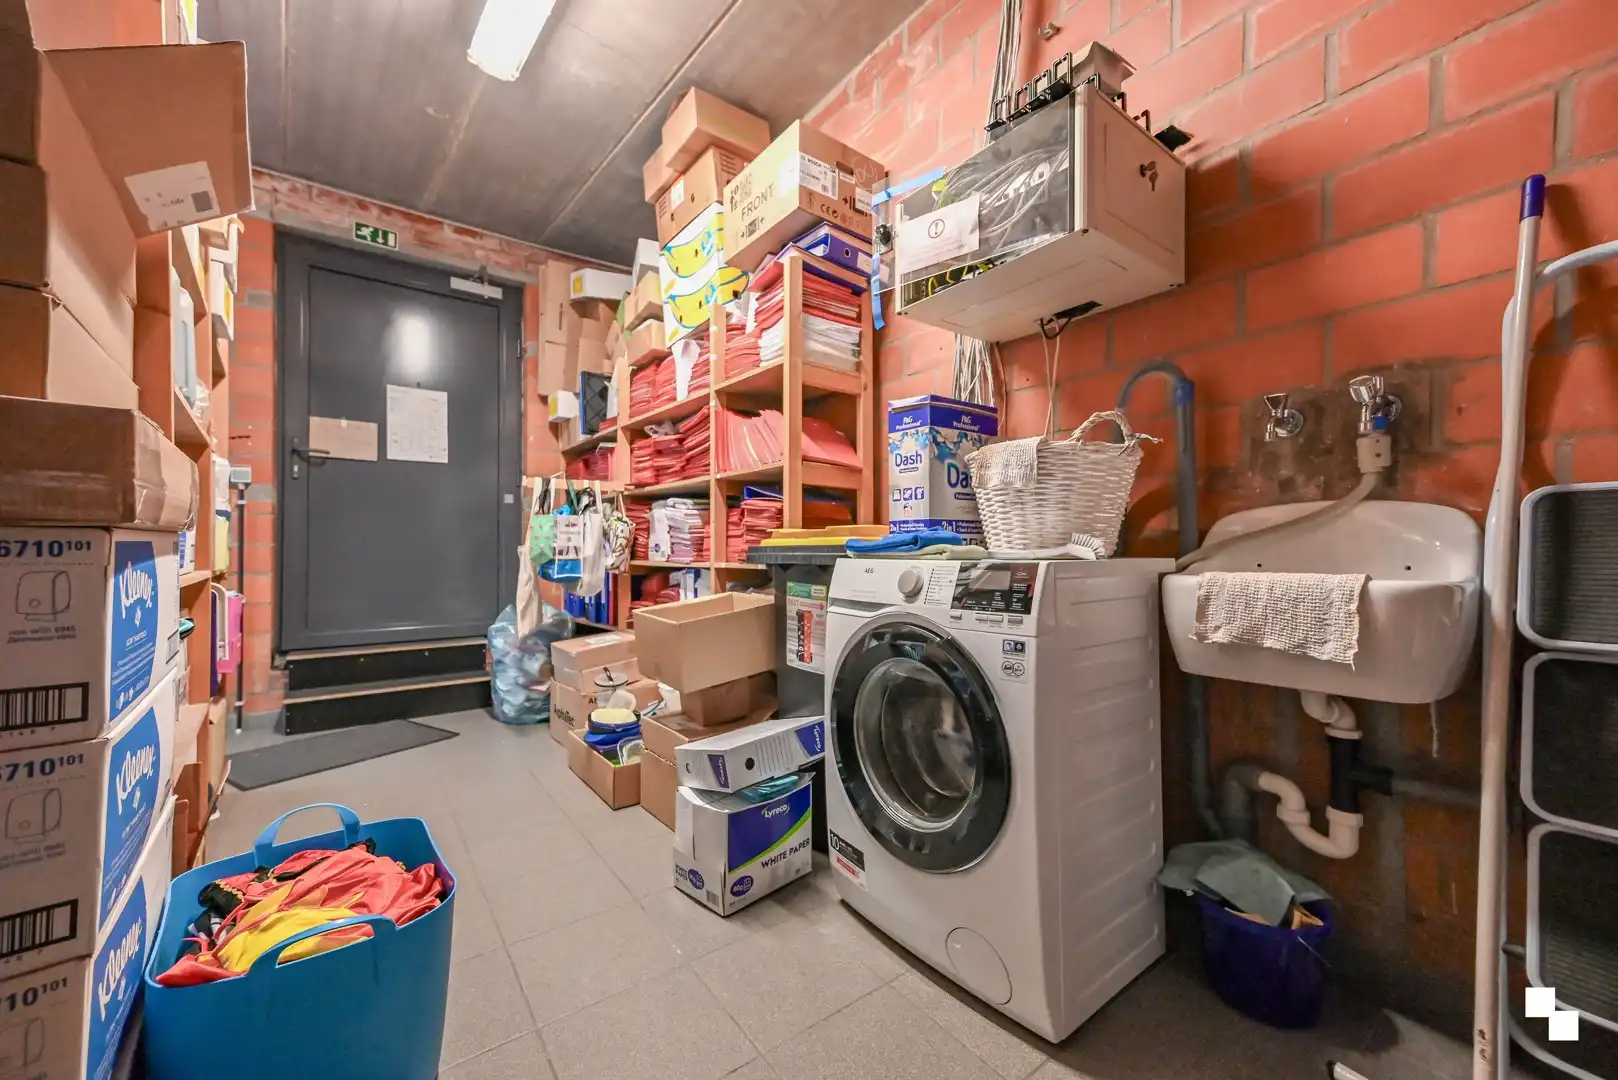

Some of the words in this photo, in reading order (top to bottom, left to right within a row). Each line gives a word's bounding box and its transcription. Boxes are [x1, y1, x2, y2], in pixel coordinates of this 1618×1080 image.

[741, 182, 775, 221] FRONT
[895, 420, 922, 430] Professional
[953, 421, 981, 431] Professional
[894, 450, 923, 467] Dash
[864, 567, 874, 575] AEG
[119, 560, 154, 619] Kleenex
[0, 758, 56, 782] 710
[116, 744, 155, 815] Kleenex
[760, 851, 788, 869] WHITE
[788, 838, 811, 858] PAPER
[831, 834, 840, 850] 10
[98, 917, 143, 1022] Kleenex
